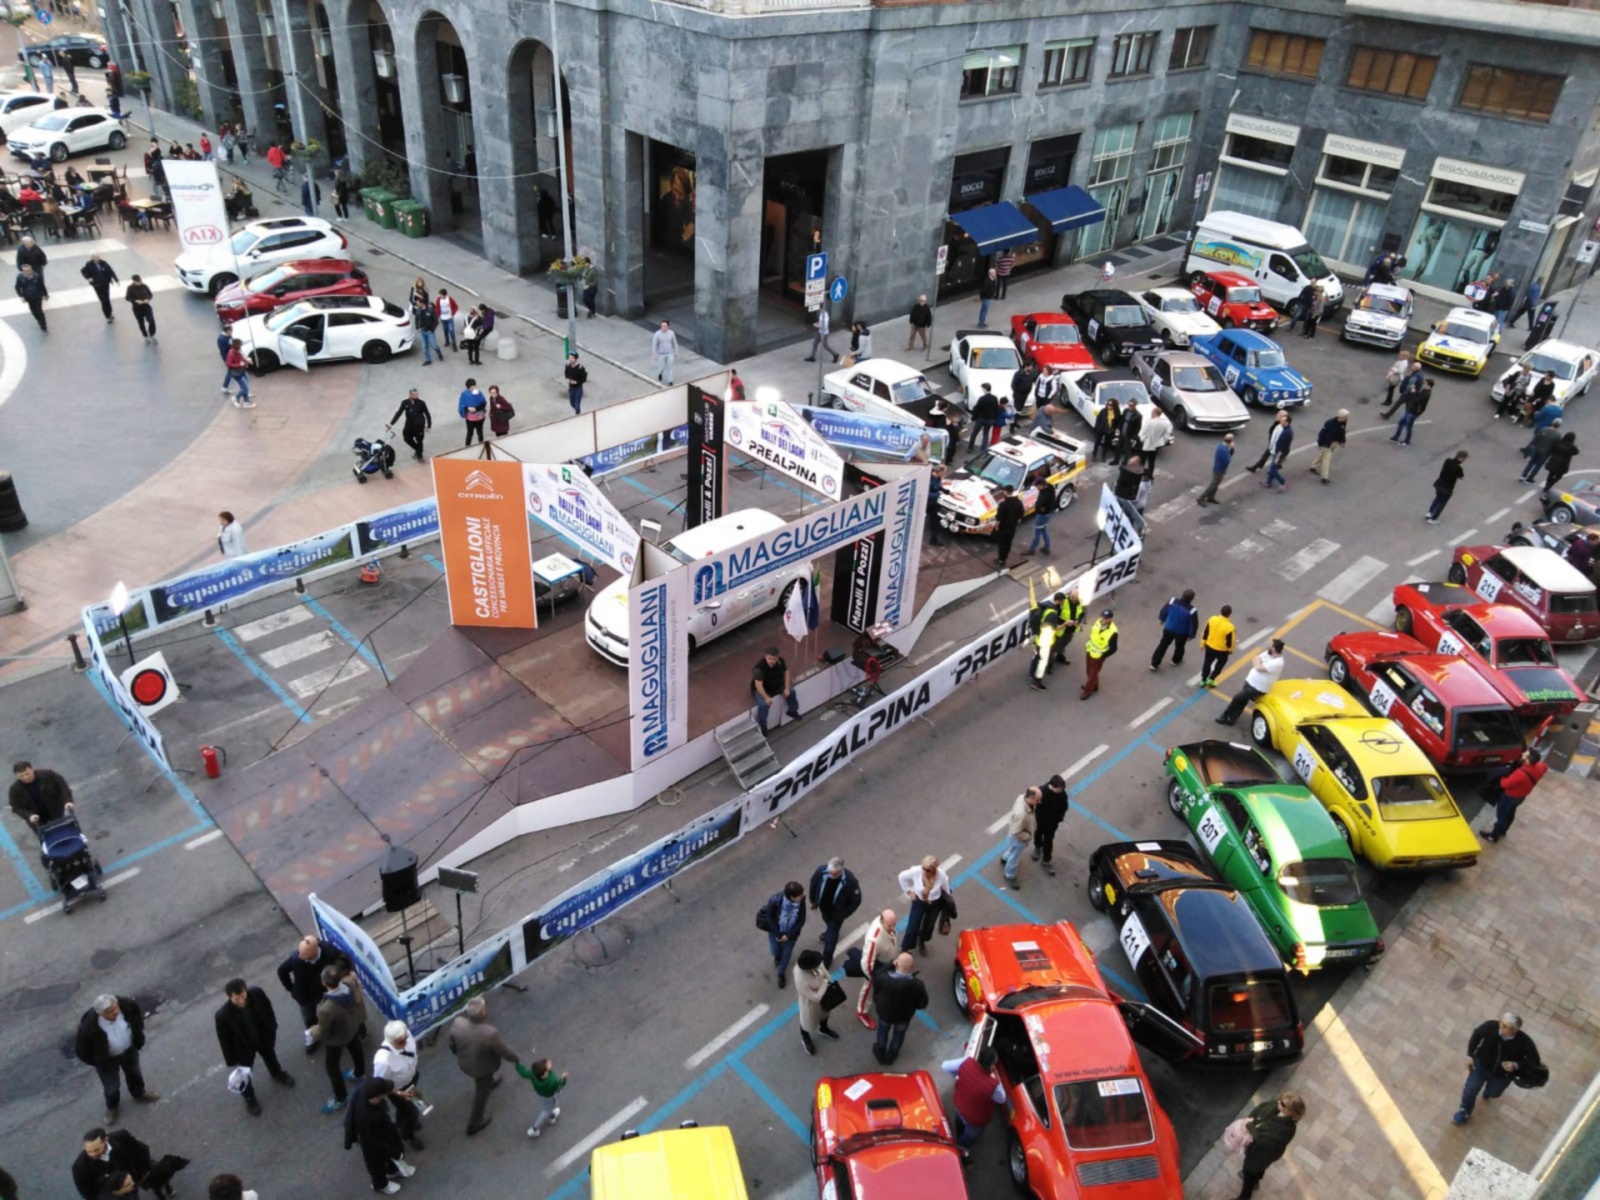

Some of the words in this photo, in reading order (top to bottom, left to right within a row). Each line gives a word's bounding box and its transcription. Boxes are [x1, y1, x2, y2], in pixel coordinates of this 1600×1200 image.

[1034, 165, 1056, 177] BOGGI
[1438, 163, 1519, 186] BRIAN&BARRY
[961, 181, 984, 193] BOGGI
[811, 257, 823, 278] P
[761, 429, 776, 444] RALLY
[778, 437, 788, 451] DEI
[789, 442, 805, 459] LAGHI
[705, 457, 713, 488] Pozzi
[748, 440, 817, 485] PREALPINA
[704, 490, 712, 499] &
[559, 495, 574, 515] RALLY
[575, 506, 585, 522] DEI
[586, 512, 602, 533] LAGHI
[492, 524, 504, 566] PROVINCIA
[558, 509, 615, 554] MAGUGLIANI
[729, 491, 887, 577] MAGUGLIANI
[884, 481, 910, 610] MAGUGLIANI
[259, 547, 333, 576] Gigliola
[466, 516, 490, 619] CASTIGLIONI
[857, 541, 869, 576] Pozzi
[496, 574, 506, 597] VARESE
[856, 578, 865, 588] &
[1480, 579, 1496, 597] 212
[711, 612, 717, 626] 0
[851, 589, 864, 627] Marelli
[640, 586, 659, 733] MAGUGLIANI
[1374, 689, 1388, 711] 204
[769, 681, 930, 812] PREALPINA
[1295, 753, 1311, 778] 210
[1202, 817, 1219, 844] 207
[539, 873, 636, 941] Capanna
[641, 828, 720, 878] Gigliola
[1124, 927, 1140, 959] 211
[1101, 1081, 1118, 1096] 104
